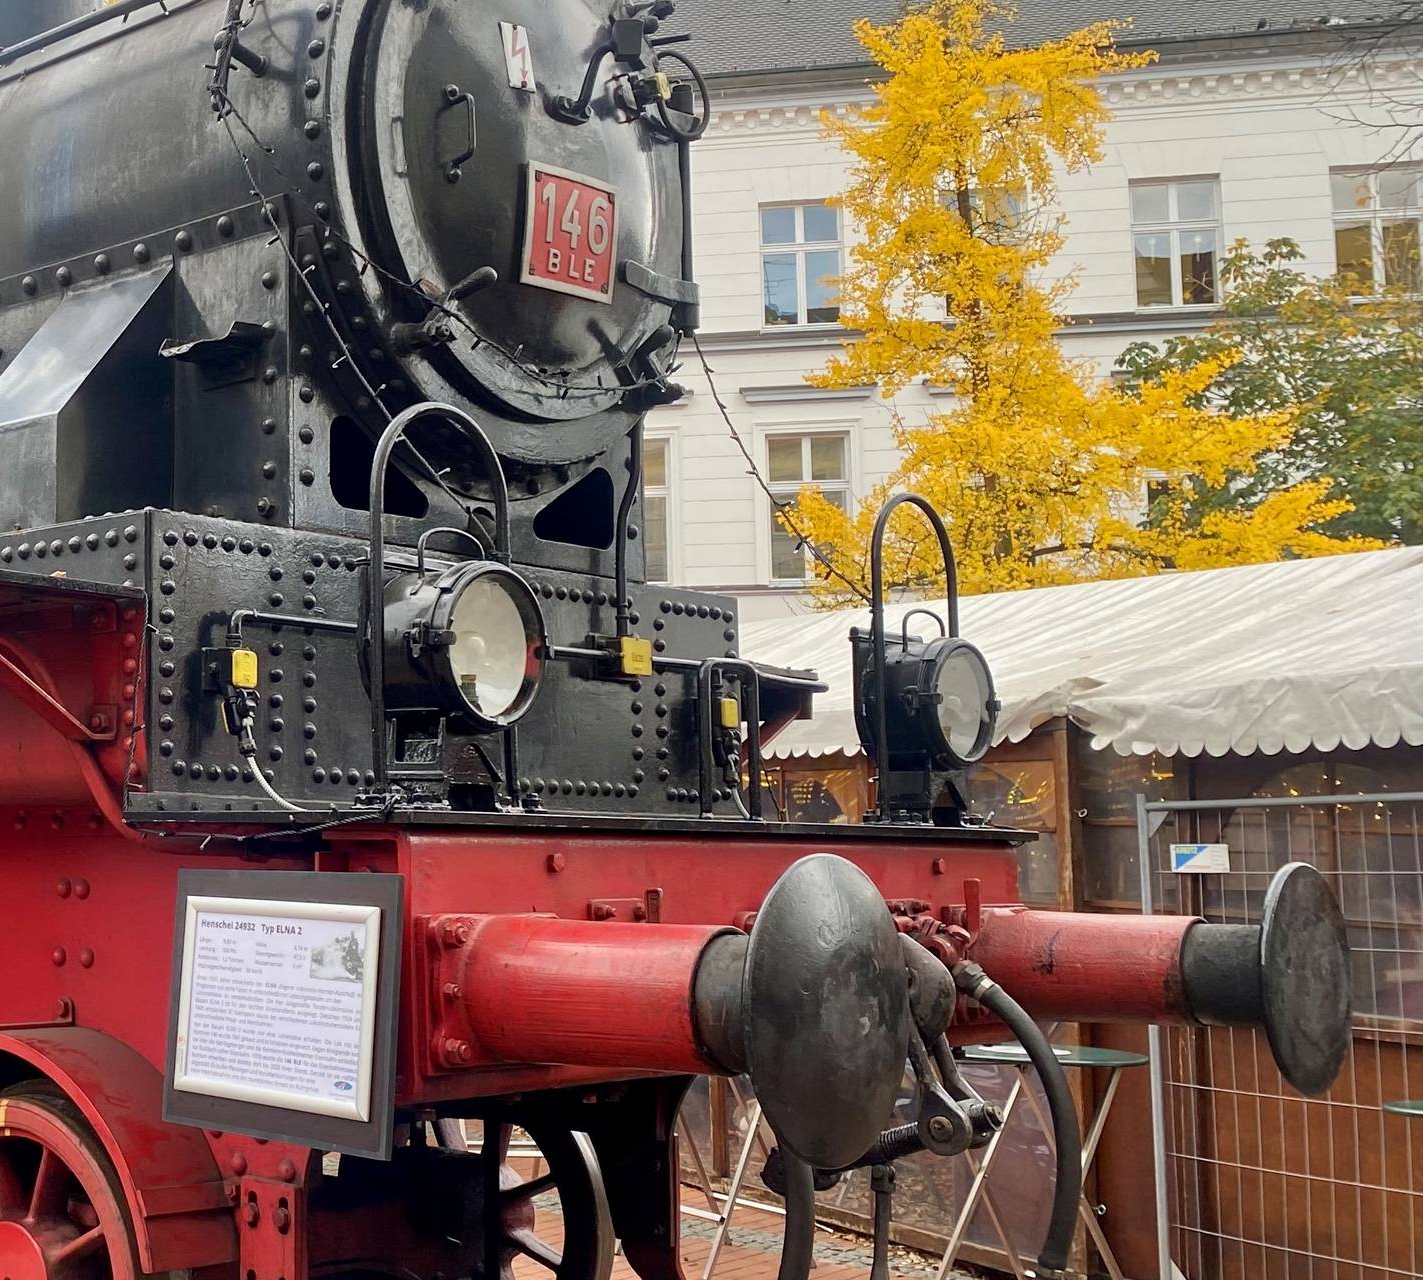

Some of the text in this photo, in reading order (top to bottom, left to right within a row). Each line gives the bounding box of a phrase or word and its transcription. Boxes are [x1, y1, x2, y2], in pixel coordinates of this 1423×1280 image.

[542, 182, 609, 255] 146
[547, 247, 596, 283] BLE
[201, 919, 303, 935] Henschel 24932 Typ ELNA 2
